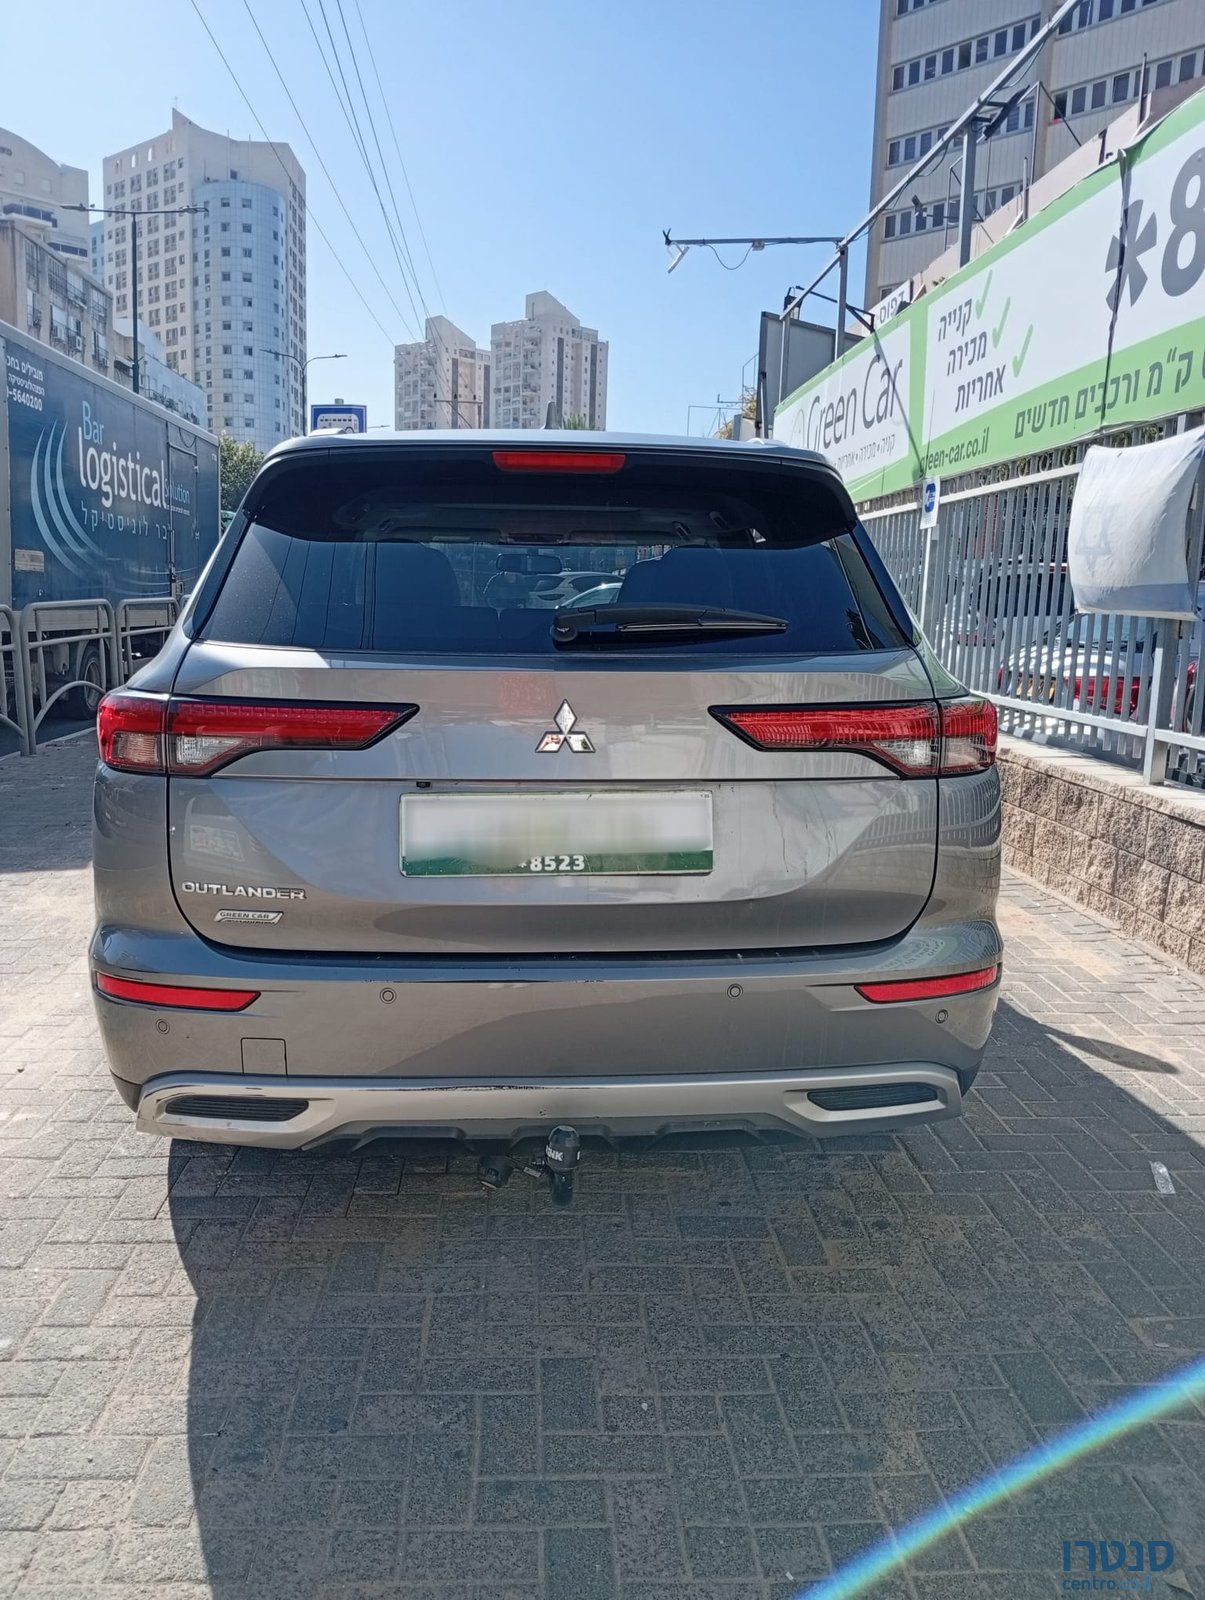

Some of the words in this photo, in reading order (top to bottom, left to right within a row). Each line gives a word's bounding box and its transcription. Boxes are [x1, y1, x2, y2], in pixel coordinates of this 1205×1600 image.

[938, 298, 973, 343] קנייה
[947, 331, 987, 377] מכירה
[807, 387, 857, 452] Green
[862, 354, 903, 430] Car
[954, 364, 1007, 413] אחריות
[82, 400, 104, 445] Bar
[1014, 396, 1069, 439] חדשים
[78, 426, 167, 509] logistical
[181, 881, 307, 900] OUTLANDER
